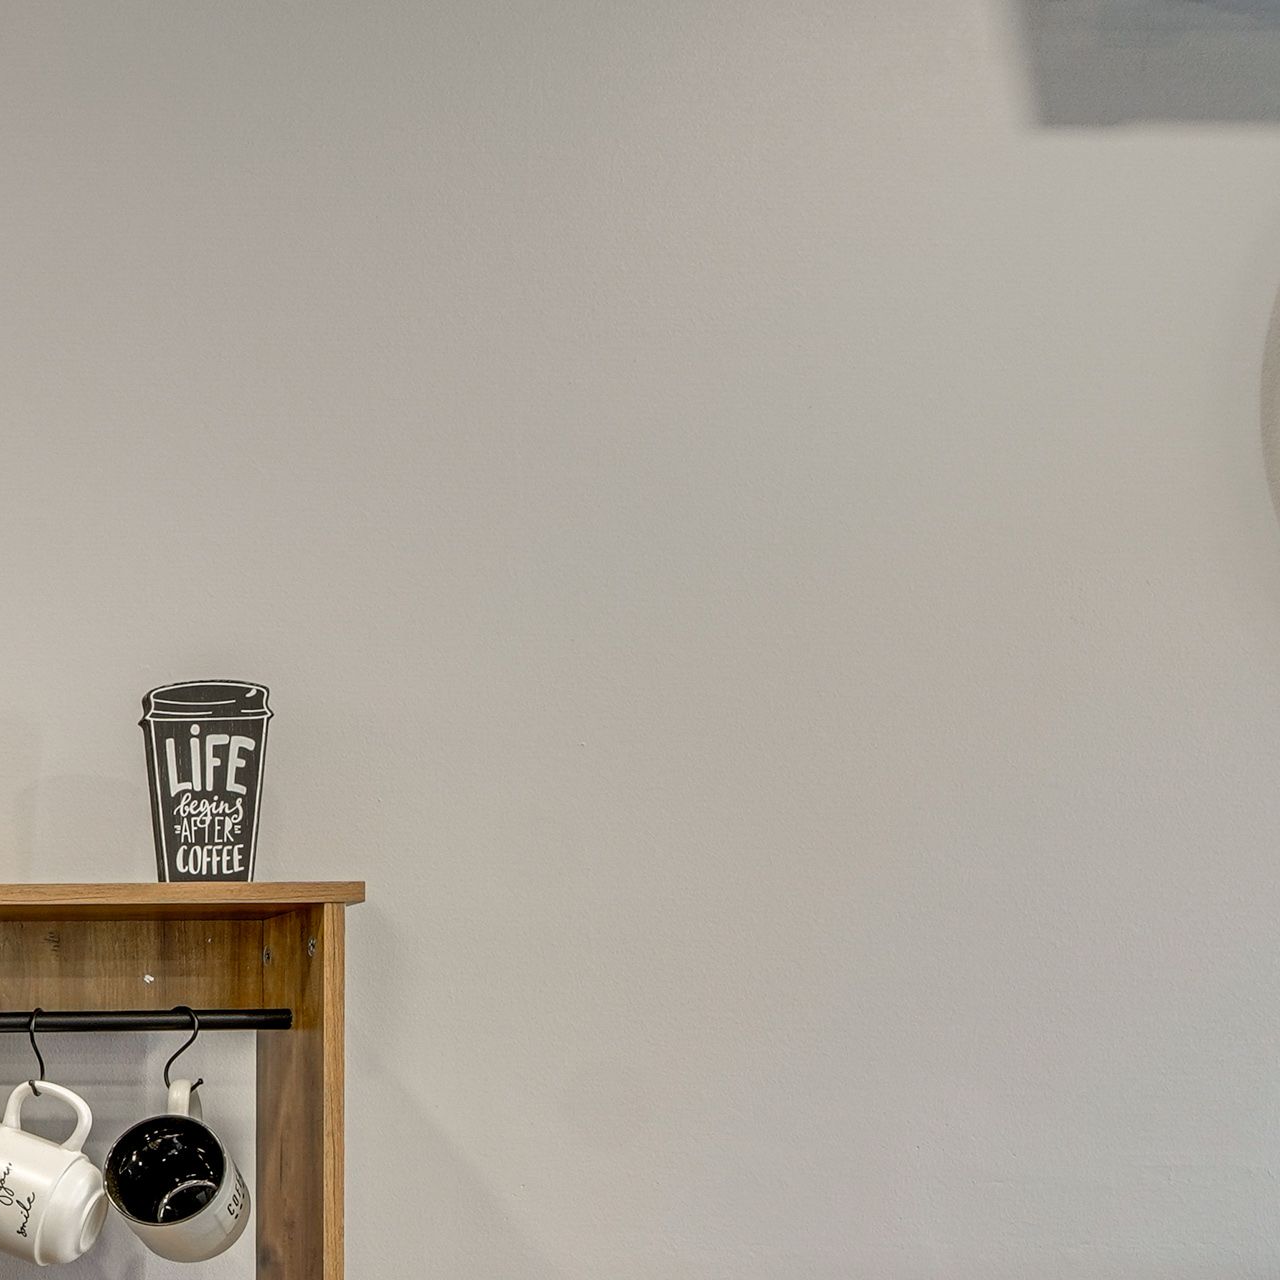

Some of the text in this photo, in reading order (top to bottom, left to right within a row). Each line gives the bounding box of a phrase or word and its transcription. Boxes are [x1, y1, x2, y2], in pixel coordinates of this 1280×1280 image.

[173, 792, 244, 828] begins
[180, 816, 235, 843] AFTER
[175, 844, 245, 876] COFFEE
[16, 1191, 36, 1238] smile
